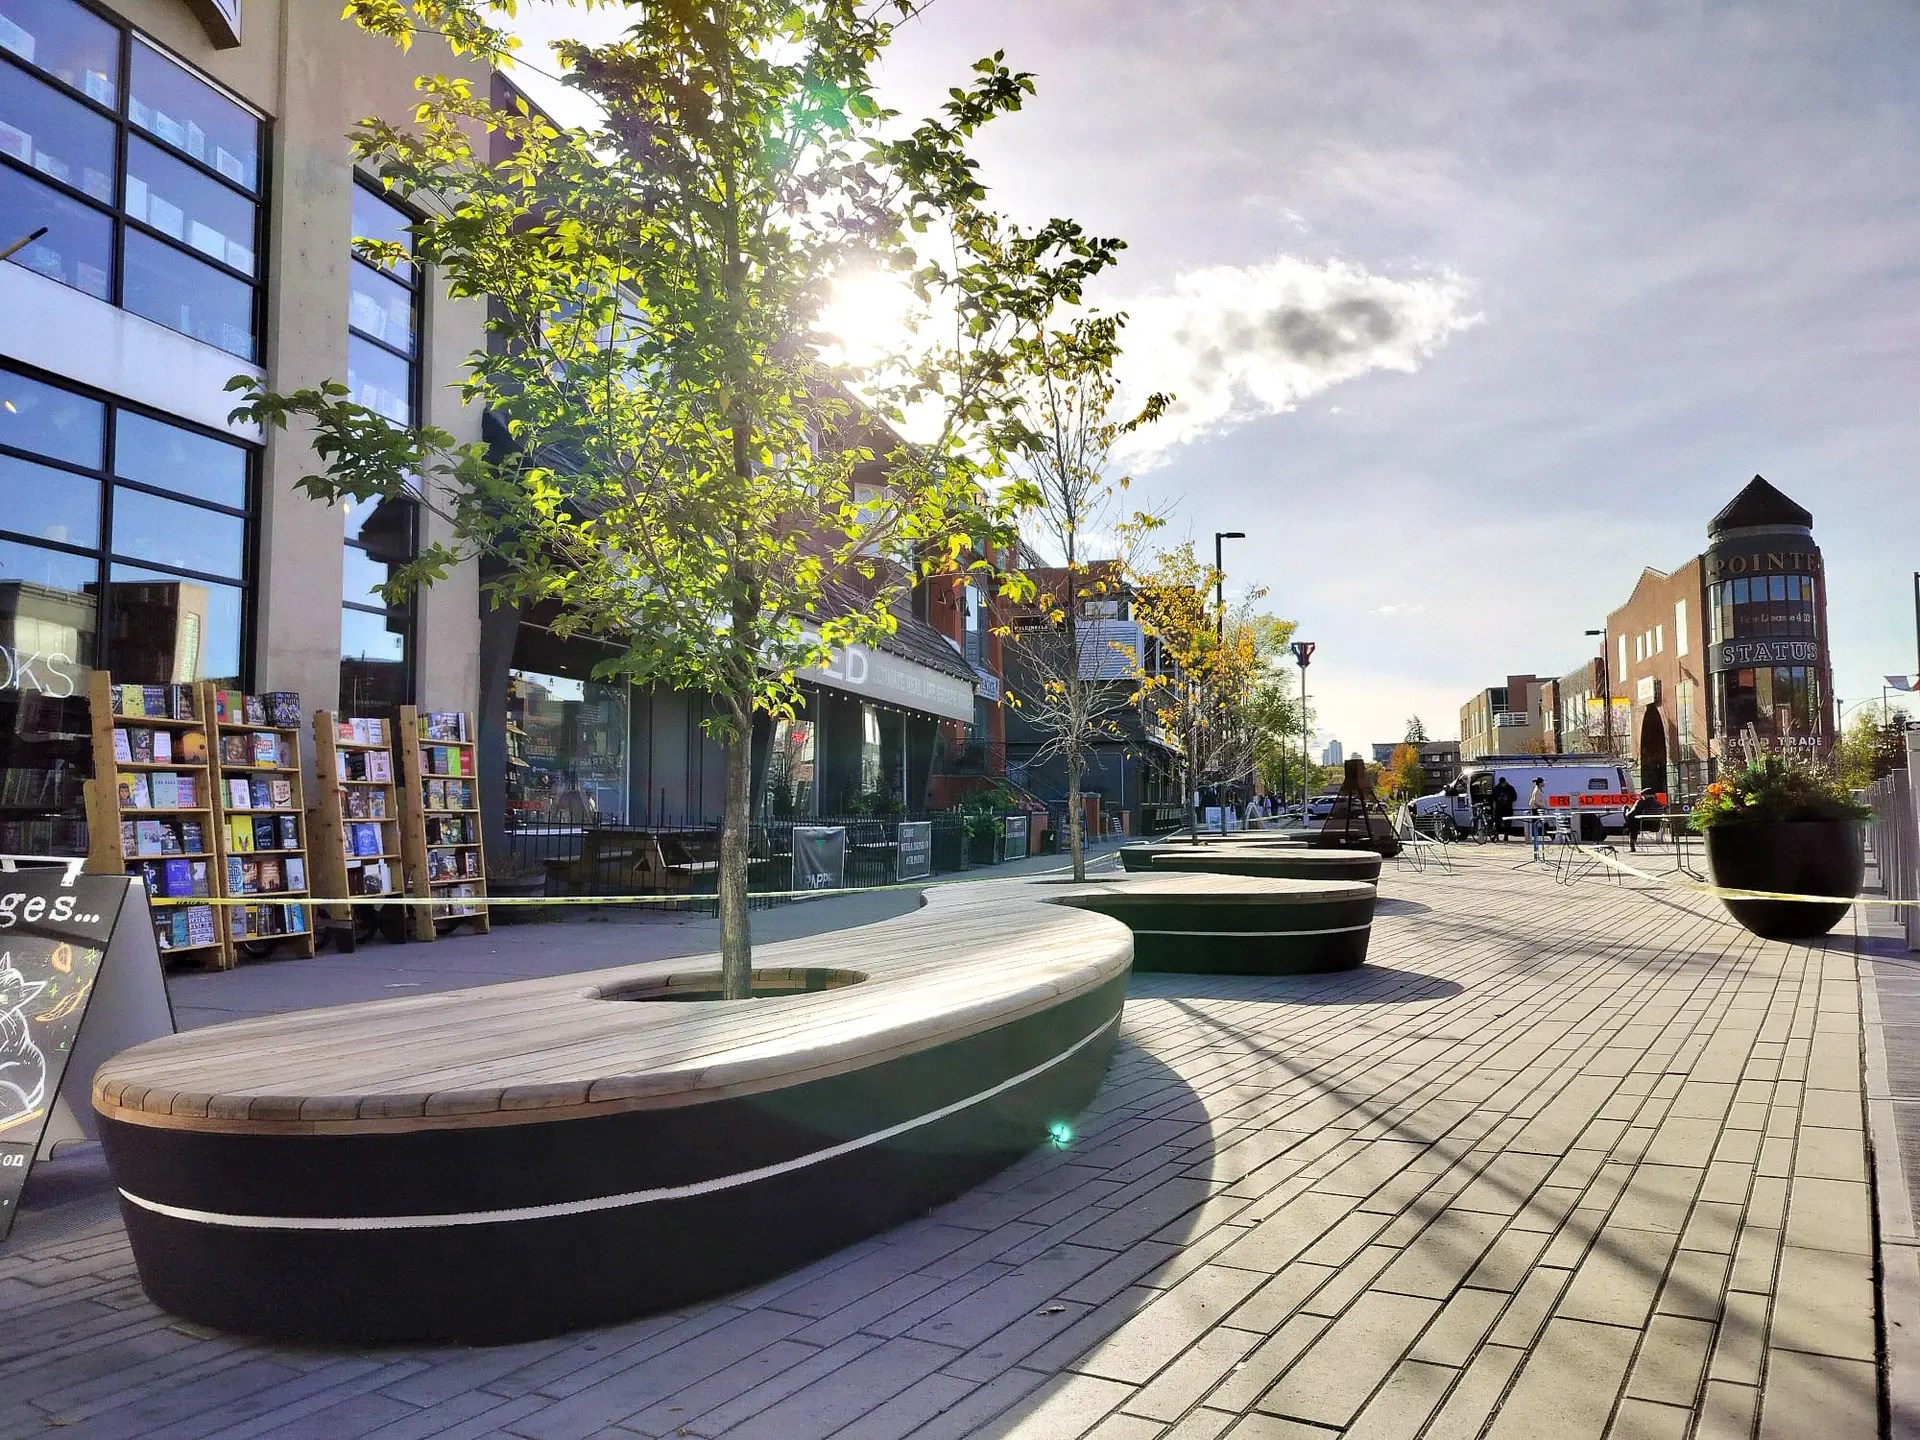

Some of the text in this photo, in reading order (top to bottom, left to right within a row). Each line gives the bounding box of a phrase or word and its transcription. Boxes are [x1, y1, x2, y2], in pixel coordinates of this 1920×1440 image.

[1723, 641, 1818, 665] STATUS
[1777, 736, 1822, 747] TRADE
[1600, 793, 1638, 805] CLOS
[0, 893, 100, 928] ges...
[0, 1152, 24, 1167] on
